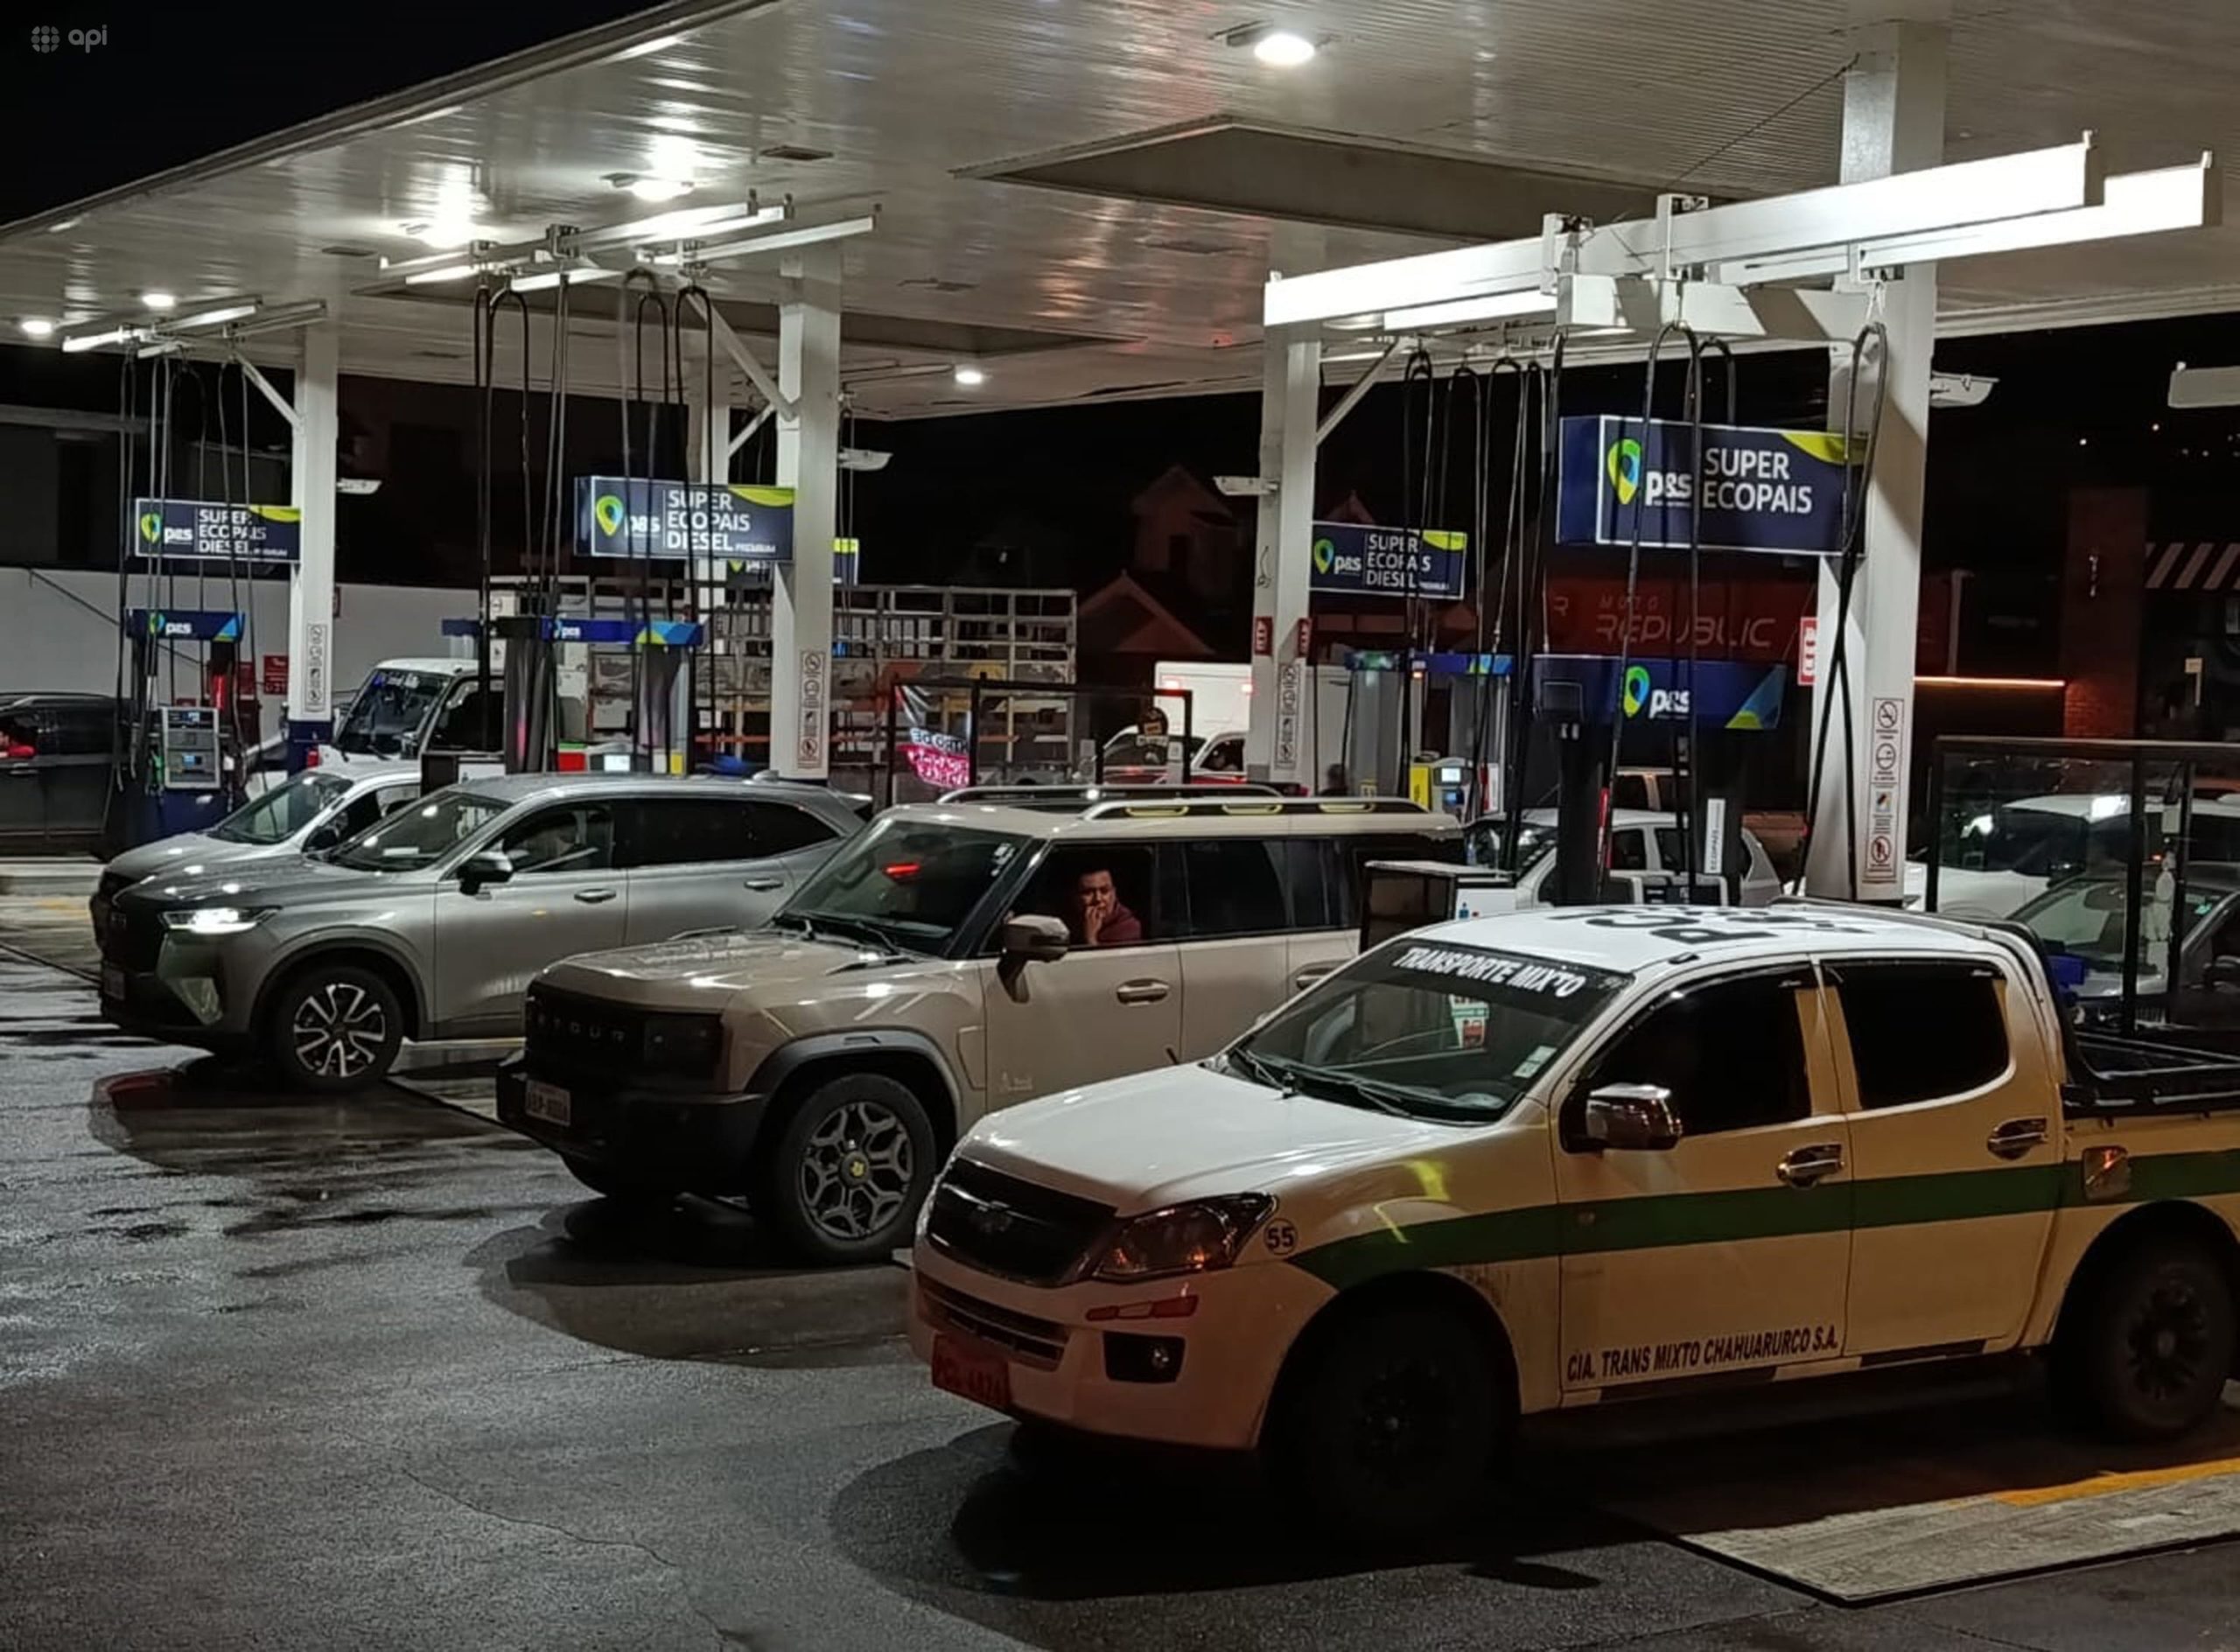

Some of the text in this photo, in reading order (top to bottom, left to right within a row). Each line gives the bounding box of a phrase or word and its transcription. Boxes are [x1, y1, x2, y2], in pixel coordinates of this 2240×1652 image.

[1704, 448, 1790, 480] SUPER
[668, 490, 732, 510] SUPER
[1703, 481, 1812, 514] ECOPAIS
[668, 510, 750, 532] ECOPAIS
[667, 530, 733, 551] DIESEL
[1596, 614, 1776, 648] REPUBLIC
[1392, 947, 1522, 984] TRANSPORTE
[1268, 1227, 1295, 1250] 55
[1567, 1325, 1838, 1382] CIA. TRANS MIXTO CHAHUARURCO S.A.
